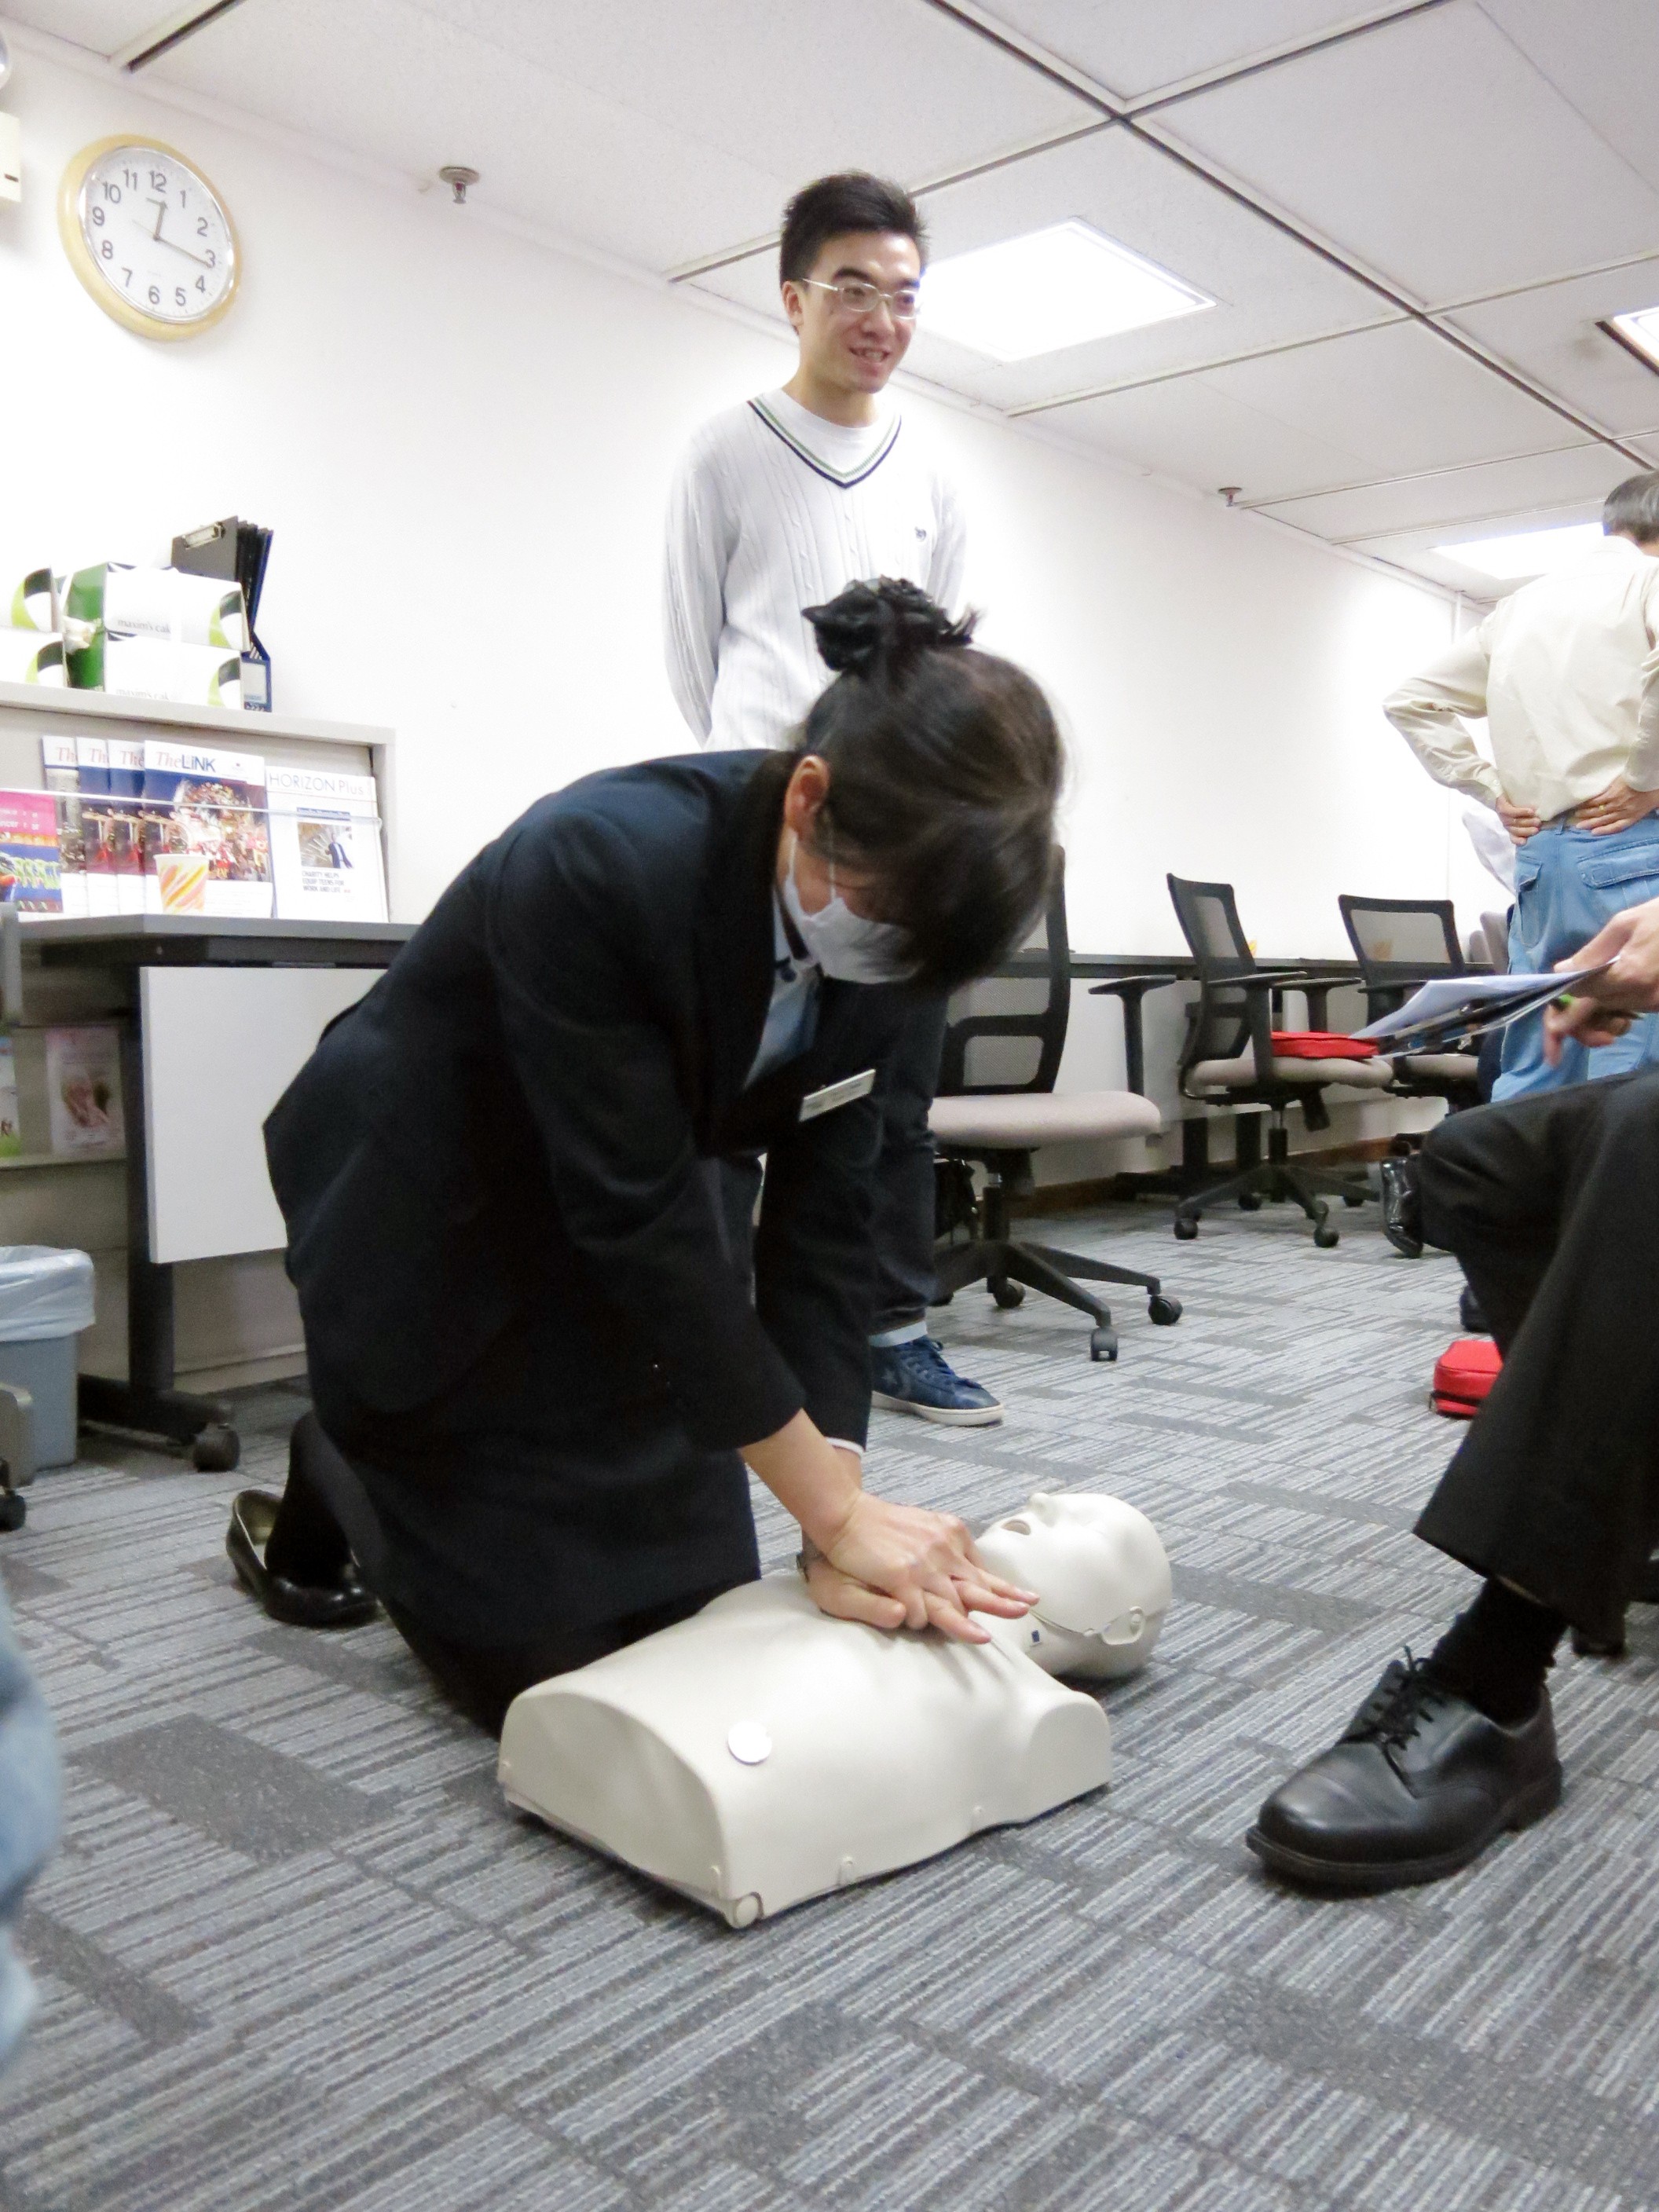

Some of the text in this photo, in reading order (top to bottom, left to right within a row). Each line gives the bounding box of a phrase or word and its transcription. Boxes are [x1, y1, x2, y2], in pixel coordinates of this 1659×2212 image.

[123, 168, 138, 191] 11
[149, 170, 167, 194] 12
[103, 181, 122, 204] 10
[180, 189, 186, 209] 1
[92, 206, 105, 226] 9
[196, 216, 208, 237] 2
[101, 240, 114, 260] 8
[205, 248, 216, 268] 3
[121, 266, 133, 287] 7
[195, 275, 207, 294] 4
[148, 285, 160, 305] 6
[175, 287, 186, 307] 5
[155, 624, 171, 634] cak
[154, 691, 169, 701] cak
[269, 773, 335, 792] HORIZON
[339, 780, 364, 795] Plus
